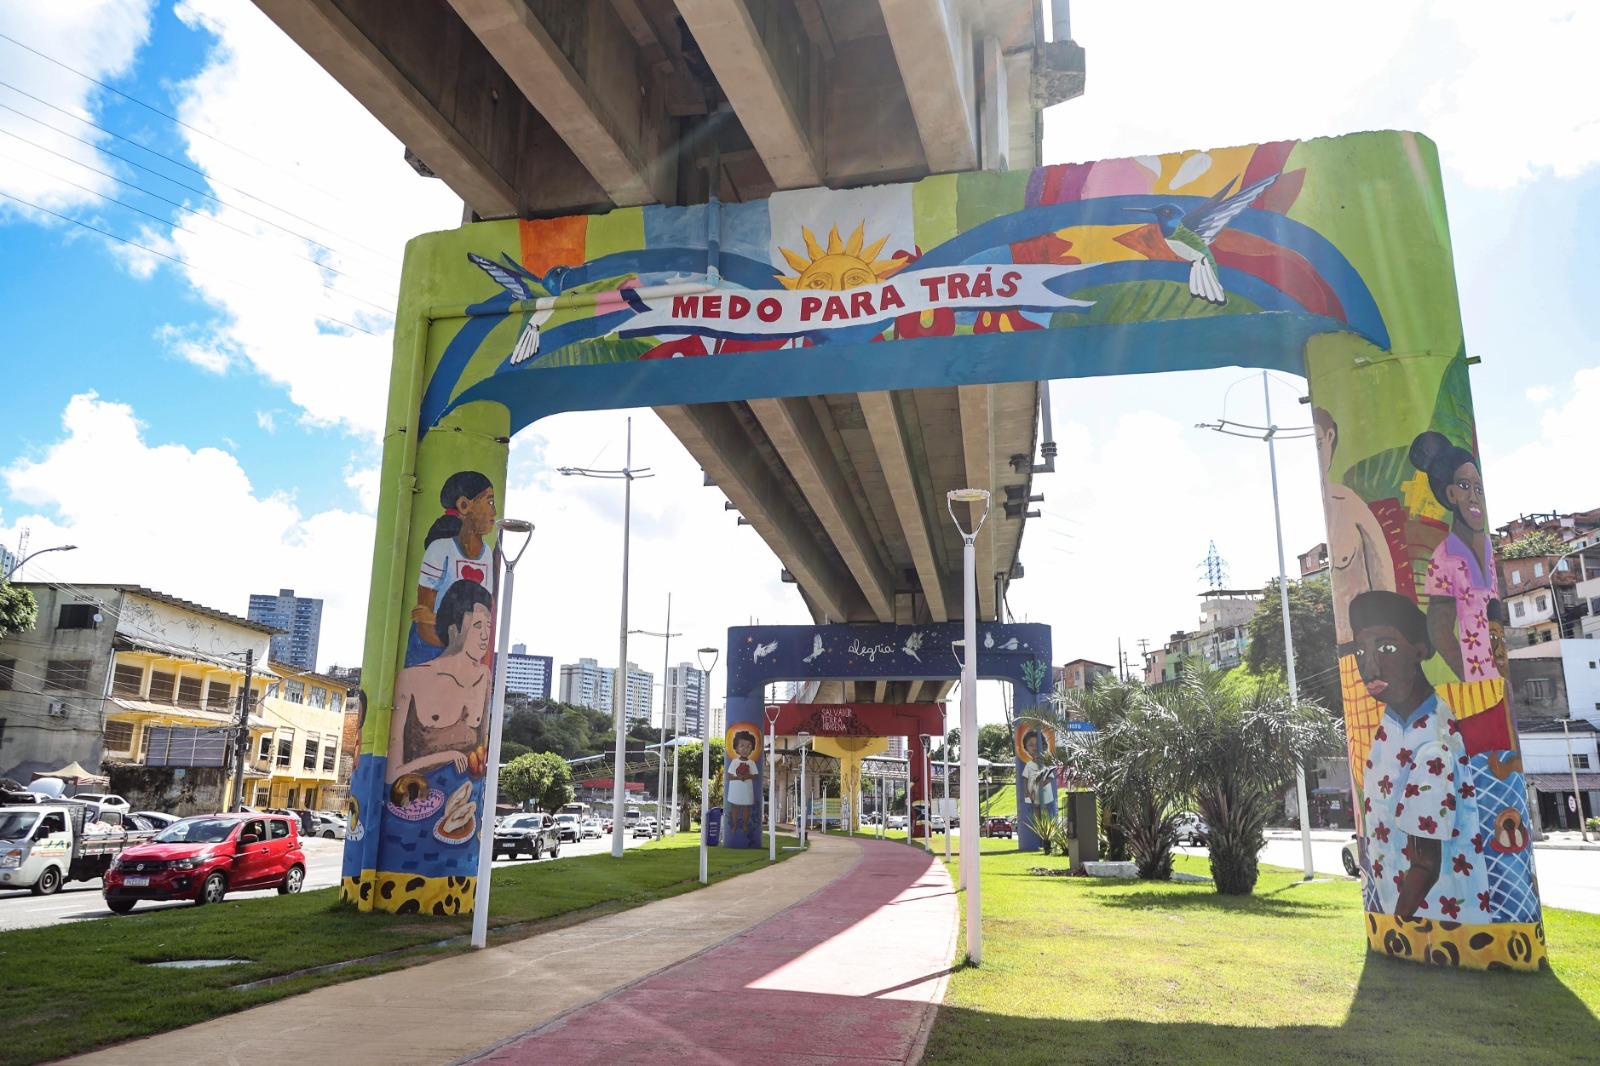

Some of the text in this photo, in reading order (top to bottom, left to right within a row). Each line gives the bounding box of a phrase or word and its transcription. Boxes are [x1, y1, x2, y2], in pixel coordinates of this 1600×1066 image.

[672, 266, 1023, 323] MEDO PARA TRÁS
